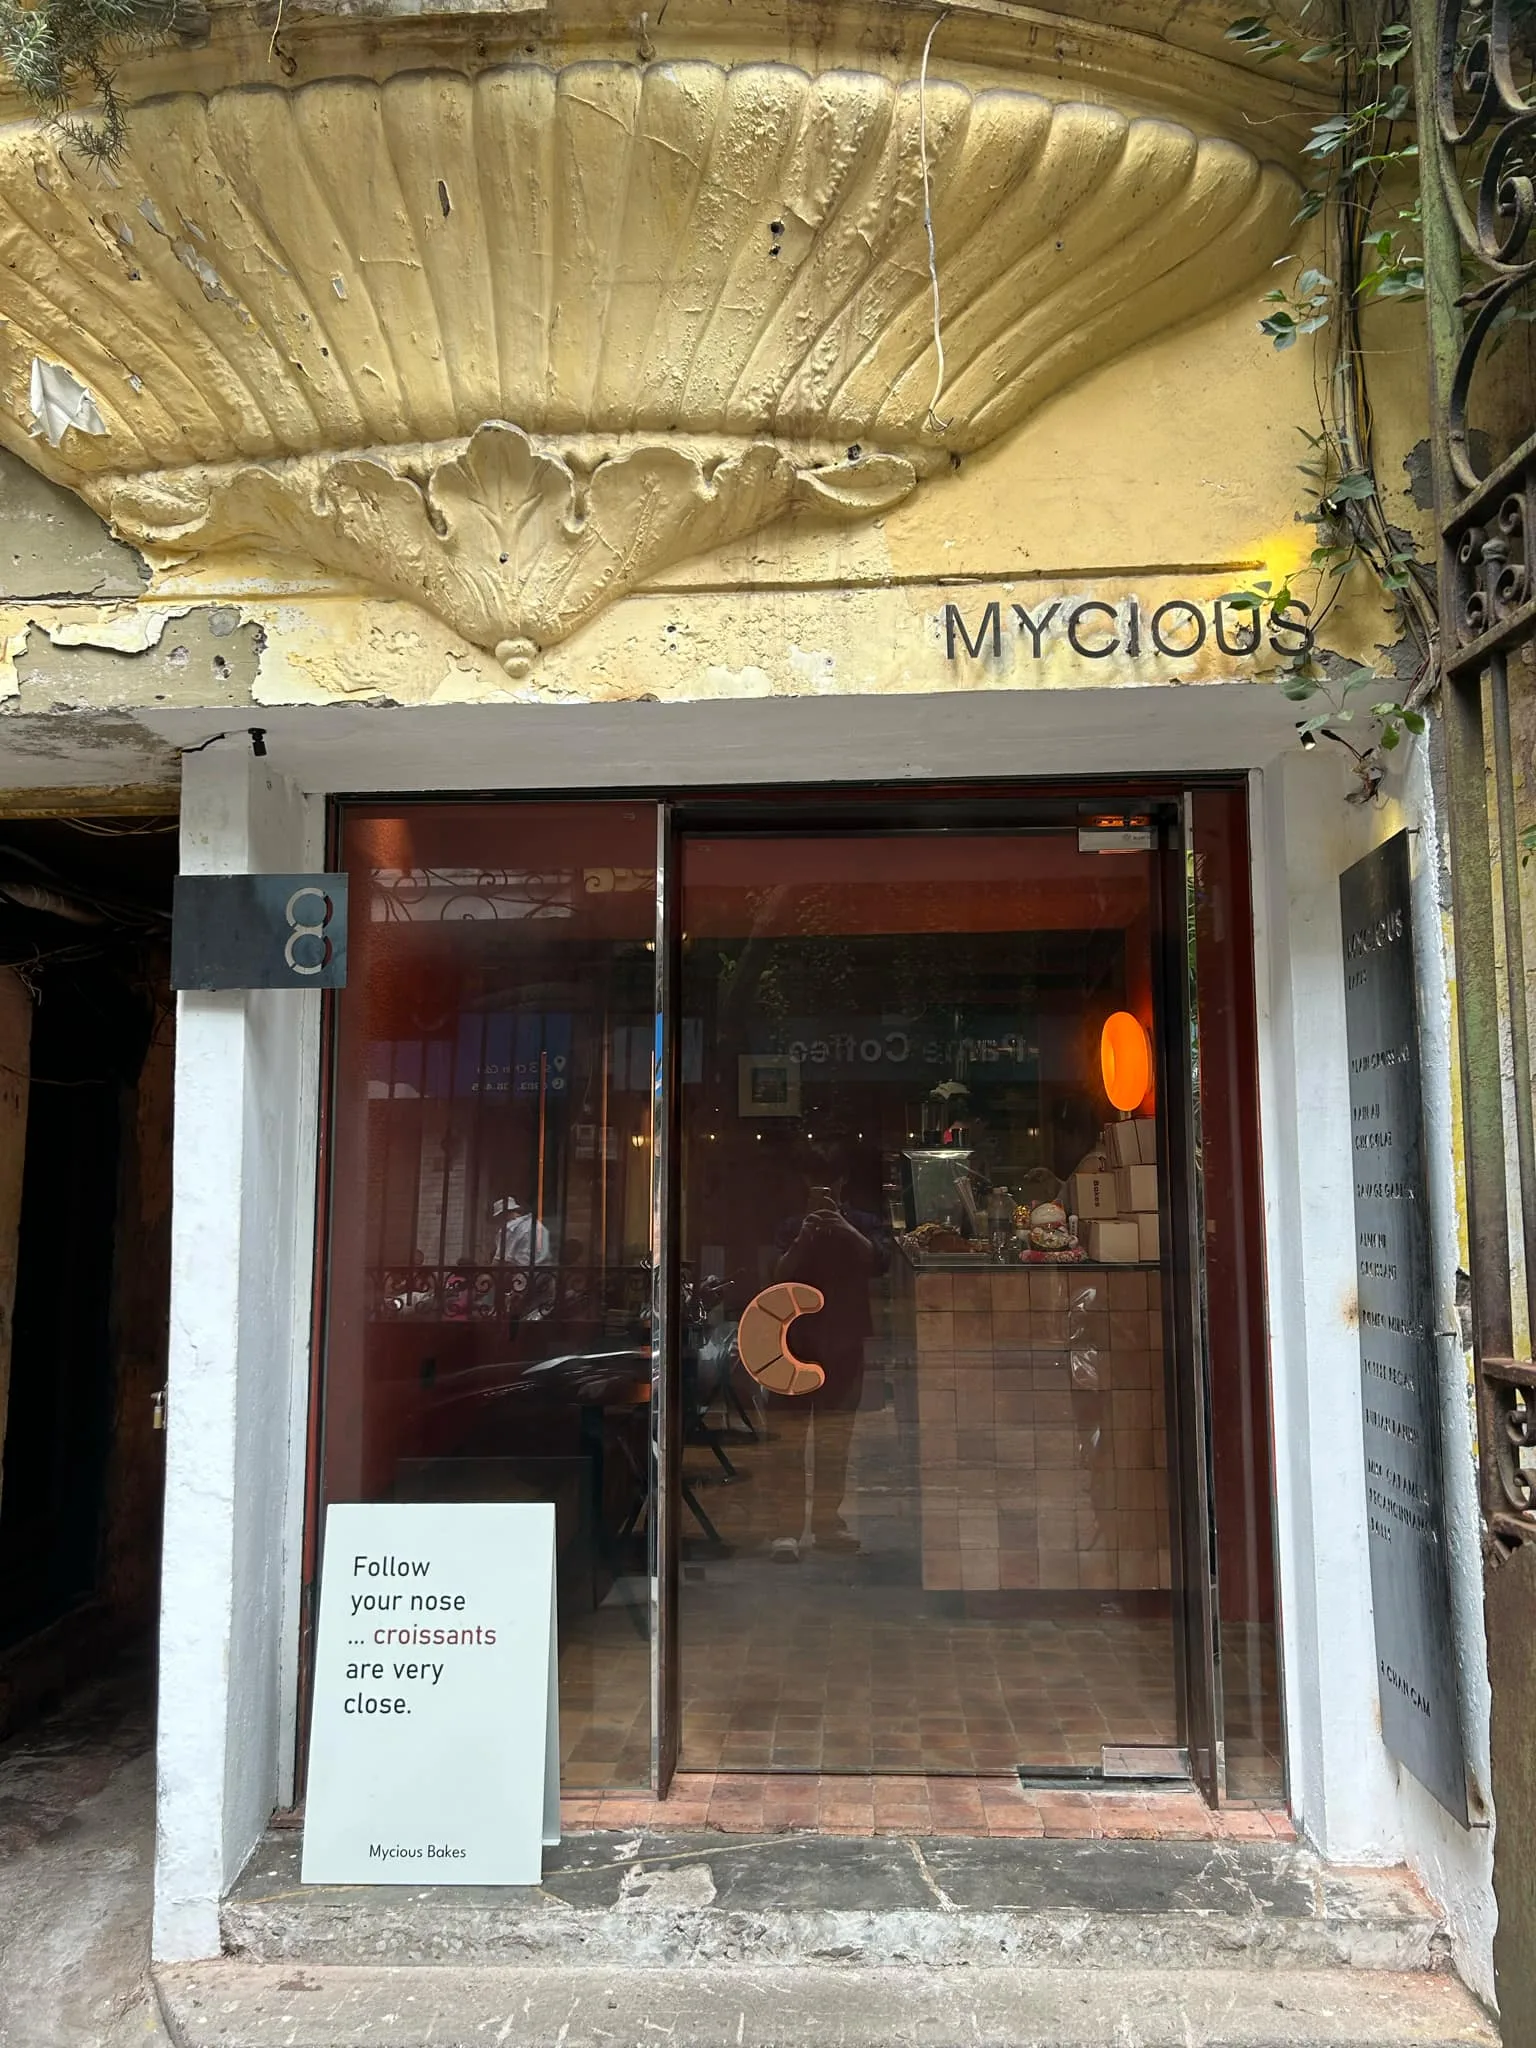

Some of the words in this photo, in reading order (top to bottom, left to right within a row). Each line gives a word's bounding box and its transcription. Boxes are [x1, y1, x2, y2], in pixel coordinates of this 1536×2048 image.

[945, 600, 1315, 660] MYCIOUS
[284, 887, 334, 976] 8
[353, 1555, 431, 1577] Follow
[350, 1594, 403, 1617] your
[410, 1594, 466, 1611] nose
[373, 1623, 497, 1645] croissants
[345, 1663, 384, 1679] are
[392, 1663, 445, 1686] very
[343, 1692, 412, 1714] close.
[368, 1843, 424, 1861] Mycious
[426, 1843, 467, 1859] Bakes
